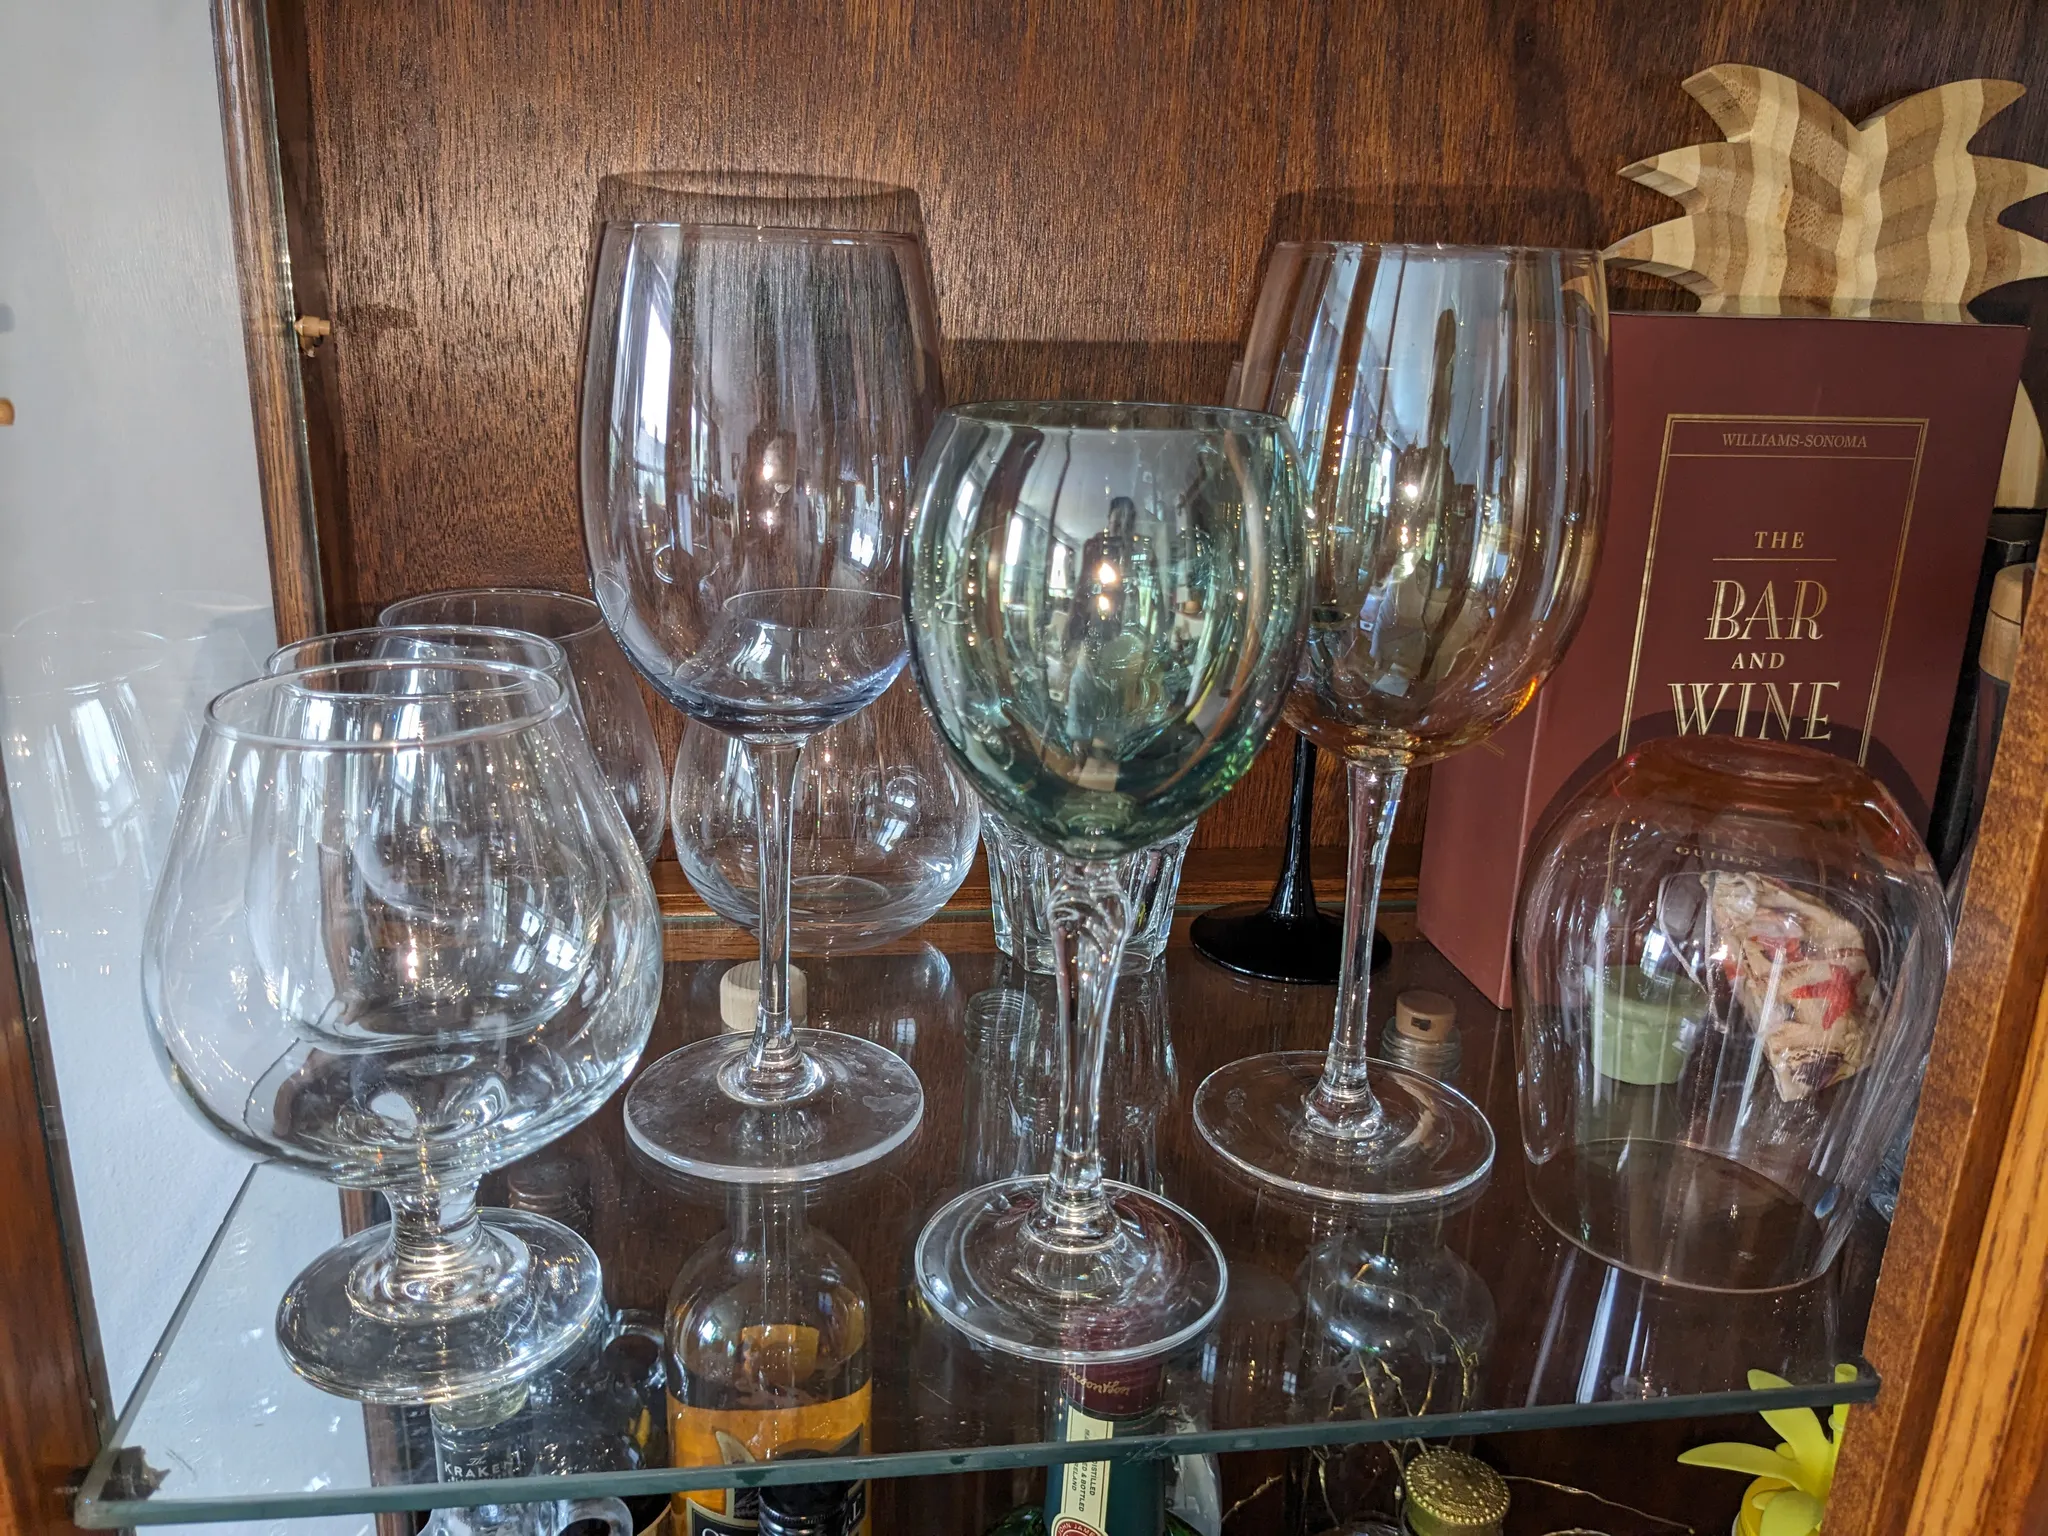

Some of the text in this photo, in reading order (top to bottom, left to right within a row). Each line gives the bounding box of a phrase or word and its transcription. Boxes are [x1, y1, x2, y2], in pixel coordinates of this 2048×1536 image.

[1722, 433, 1868, 448] WILLIAMS-SONOMA
[1754, 531, 1805, 549] THE
[1704, 579, 1828, 641] BAR
[1731, 652, 1786, 670] AND
[1667, 680, 1841, 742] WINE
[1079, 1480, 1087, 1512] BOTTLED
